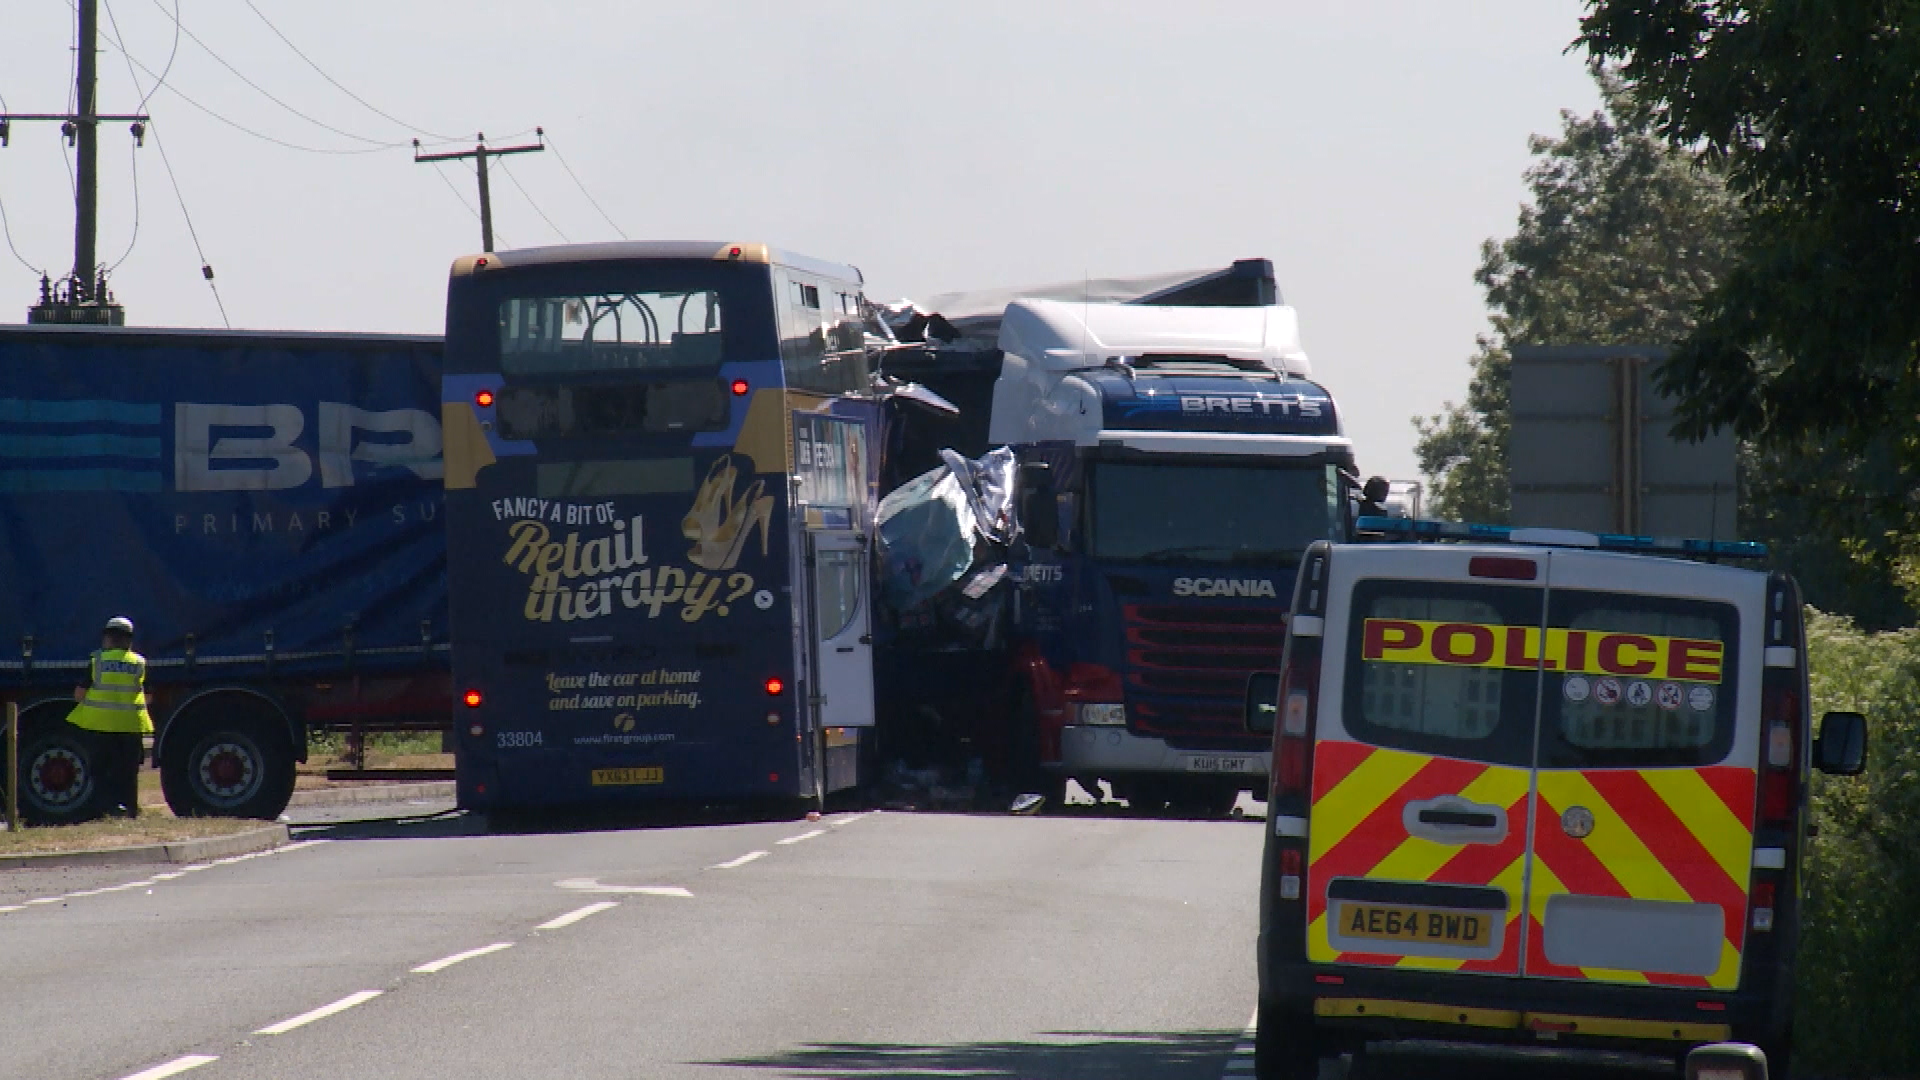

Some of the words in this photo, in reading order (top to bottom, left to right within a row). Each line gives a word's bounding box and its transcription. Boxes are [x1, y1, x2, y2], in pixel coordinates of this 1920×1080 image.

[1181, 396, 1322, 417] BRETTS
[175, 507, 357, 534] PRIMARY
[491, 497, 549, 521] FANCY
[550, 501, 561, 523] A
[566, 503, 593, 525] BIT
[595, 501, 616, 525] OF
[502, 515, 649, 580] Retail
[523, 565, 754, 623] therapy?
[1173, 577, 1277, 597] SCANIA
[1364, 619, 1722, 682] POLICE
[545, 671, 587, 695] Leave
[588, 671, 612, 688] the
[612, 673, 639, 687] car
[640, 669, 657, 685] at
[658, 667, 701, 684] home
[549, 693, 580, 711] and
[580, 695, 615, 710] save
[616, 694, 636, 708] on
[636, 690, 702, 711] parking.
[497, 730, 543, 748] 33804
[573, 733, 675, 745] www.firstgroup.com
[1351, 907, 1419, 937] AE64
[1427, 912, 1479, 940] BWD
